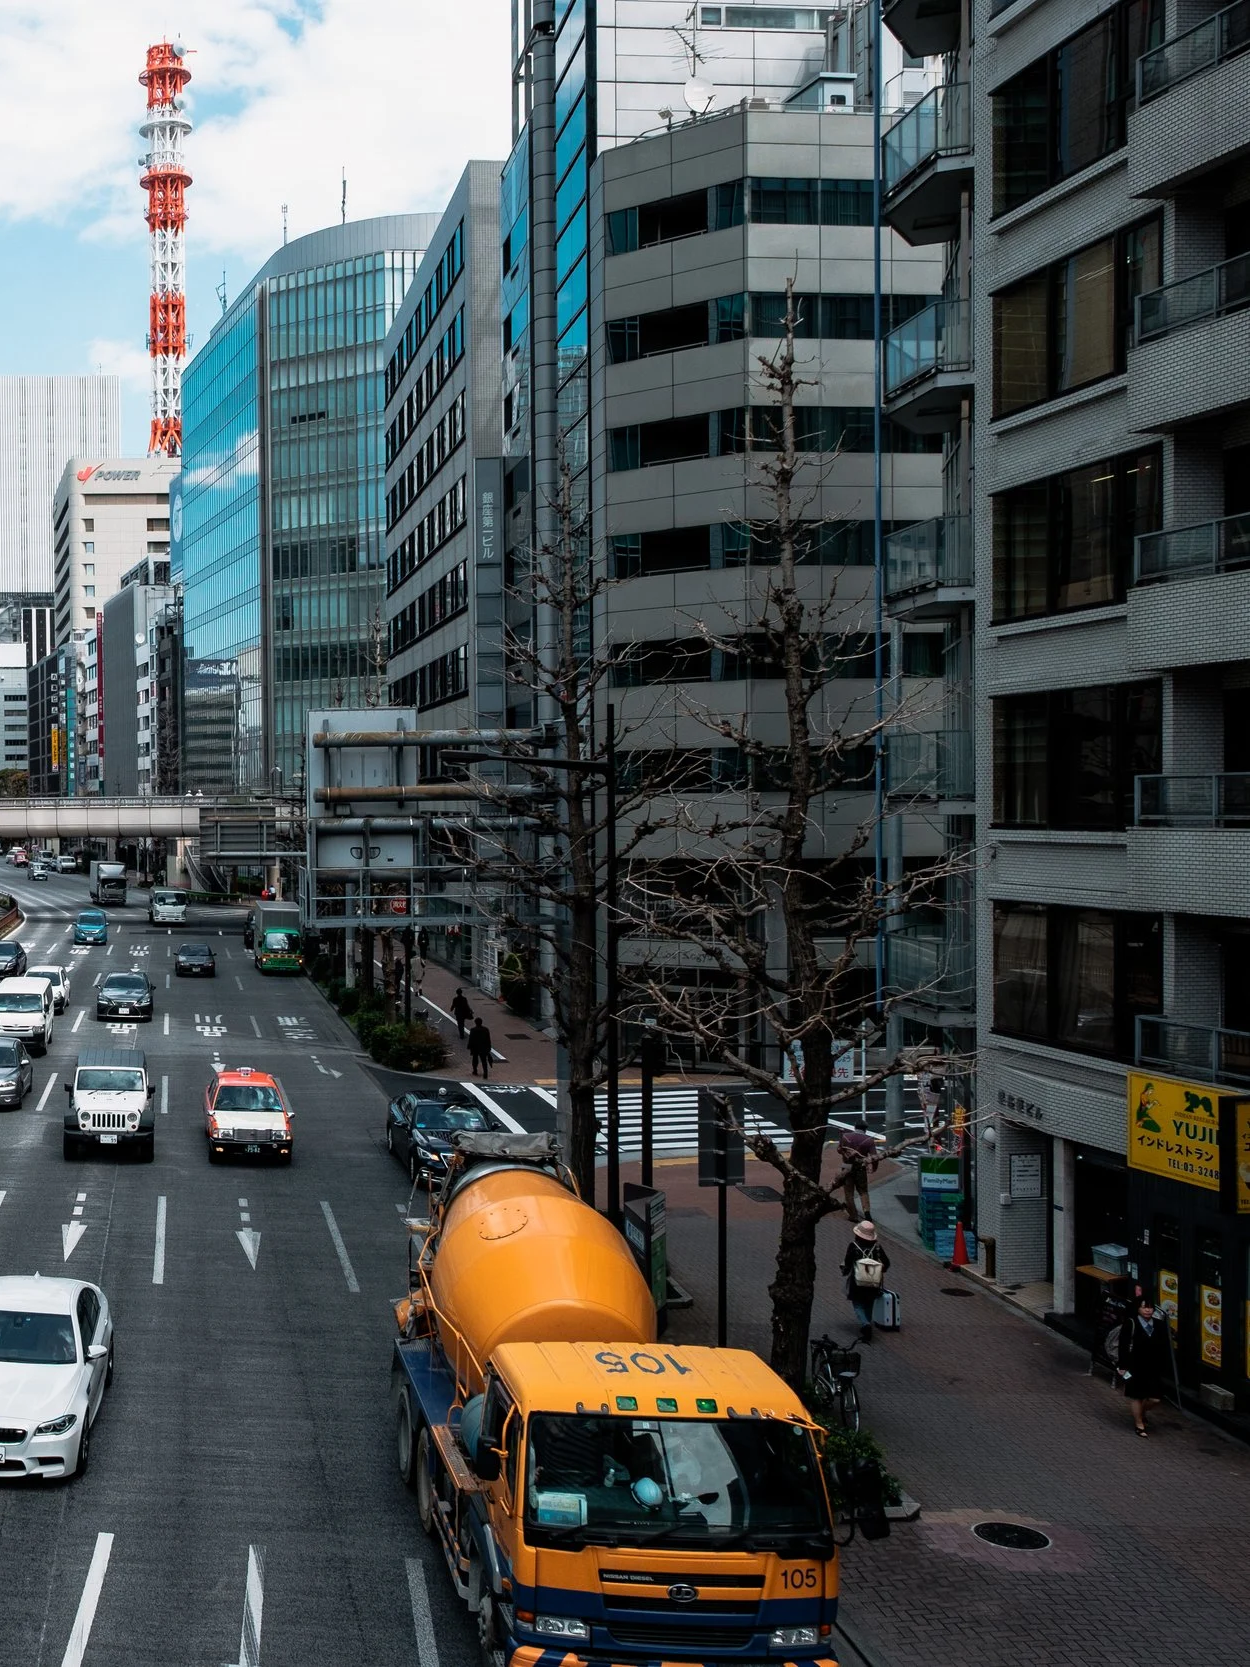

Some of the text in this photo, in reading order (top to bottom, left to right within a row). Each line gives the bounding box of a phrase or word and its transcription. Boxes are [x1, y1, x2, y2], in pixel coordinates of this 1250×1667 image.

[94, 470, 141, 481] POWER
[482, 492, 494, 559] 銀座第一ビル
[194, 1014, 228, 1036] 品川
[1172, 1119, 1219, 1145] YUJI
[1137, 1135, 1214, 1162] インドレストラン
[595, 1351, 692, 1375] 105
[781, 1568, 817, 1590] 105
